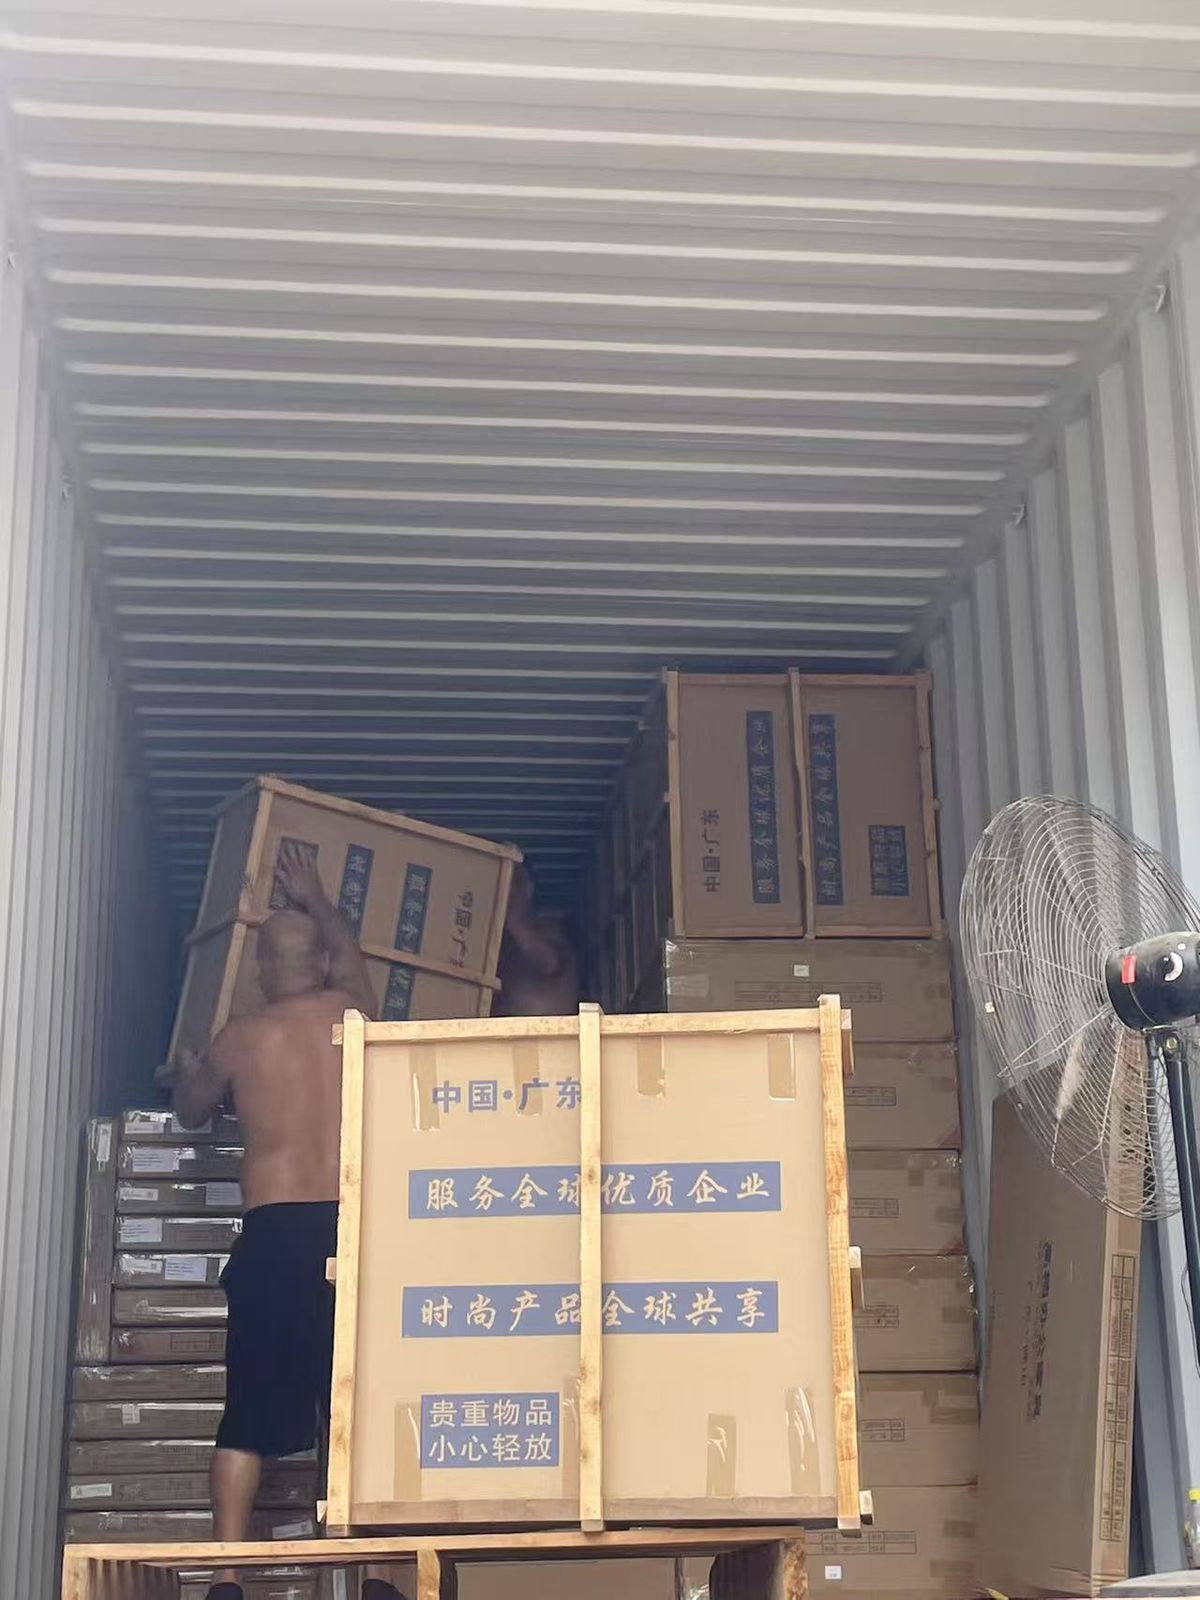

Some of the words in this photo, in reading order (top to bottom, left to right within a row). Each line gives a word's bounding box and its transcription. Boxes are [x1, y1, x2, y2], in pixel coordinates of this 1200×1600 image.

[431, 1077, 581, 1113] 中国·广东
[426, 1168, 770, 1211] 服务全球优质企业
[420, 1286, 766, 1331] 时尚产品全球共享
[429, 1399, 553, 1428] 贵重物品
[428, 1433, 553, 1463] 小心轻放
